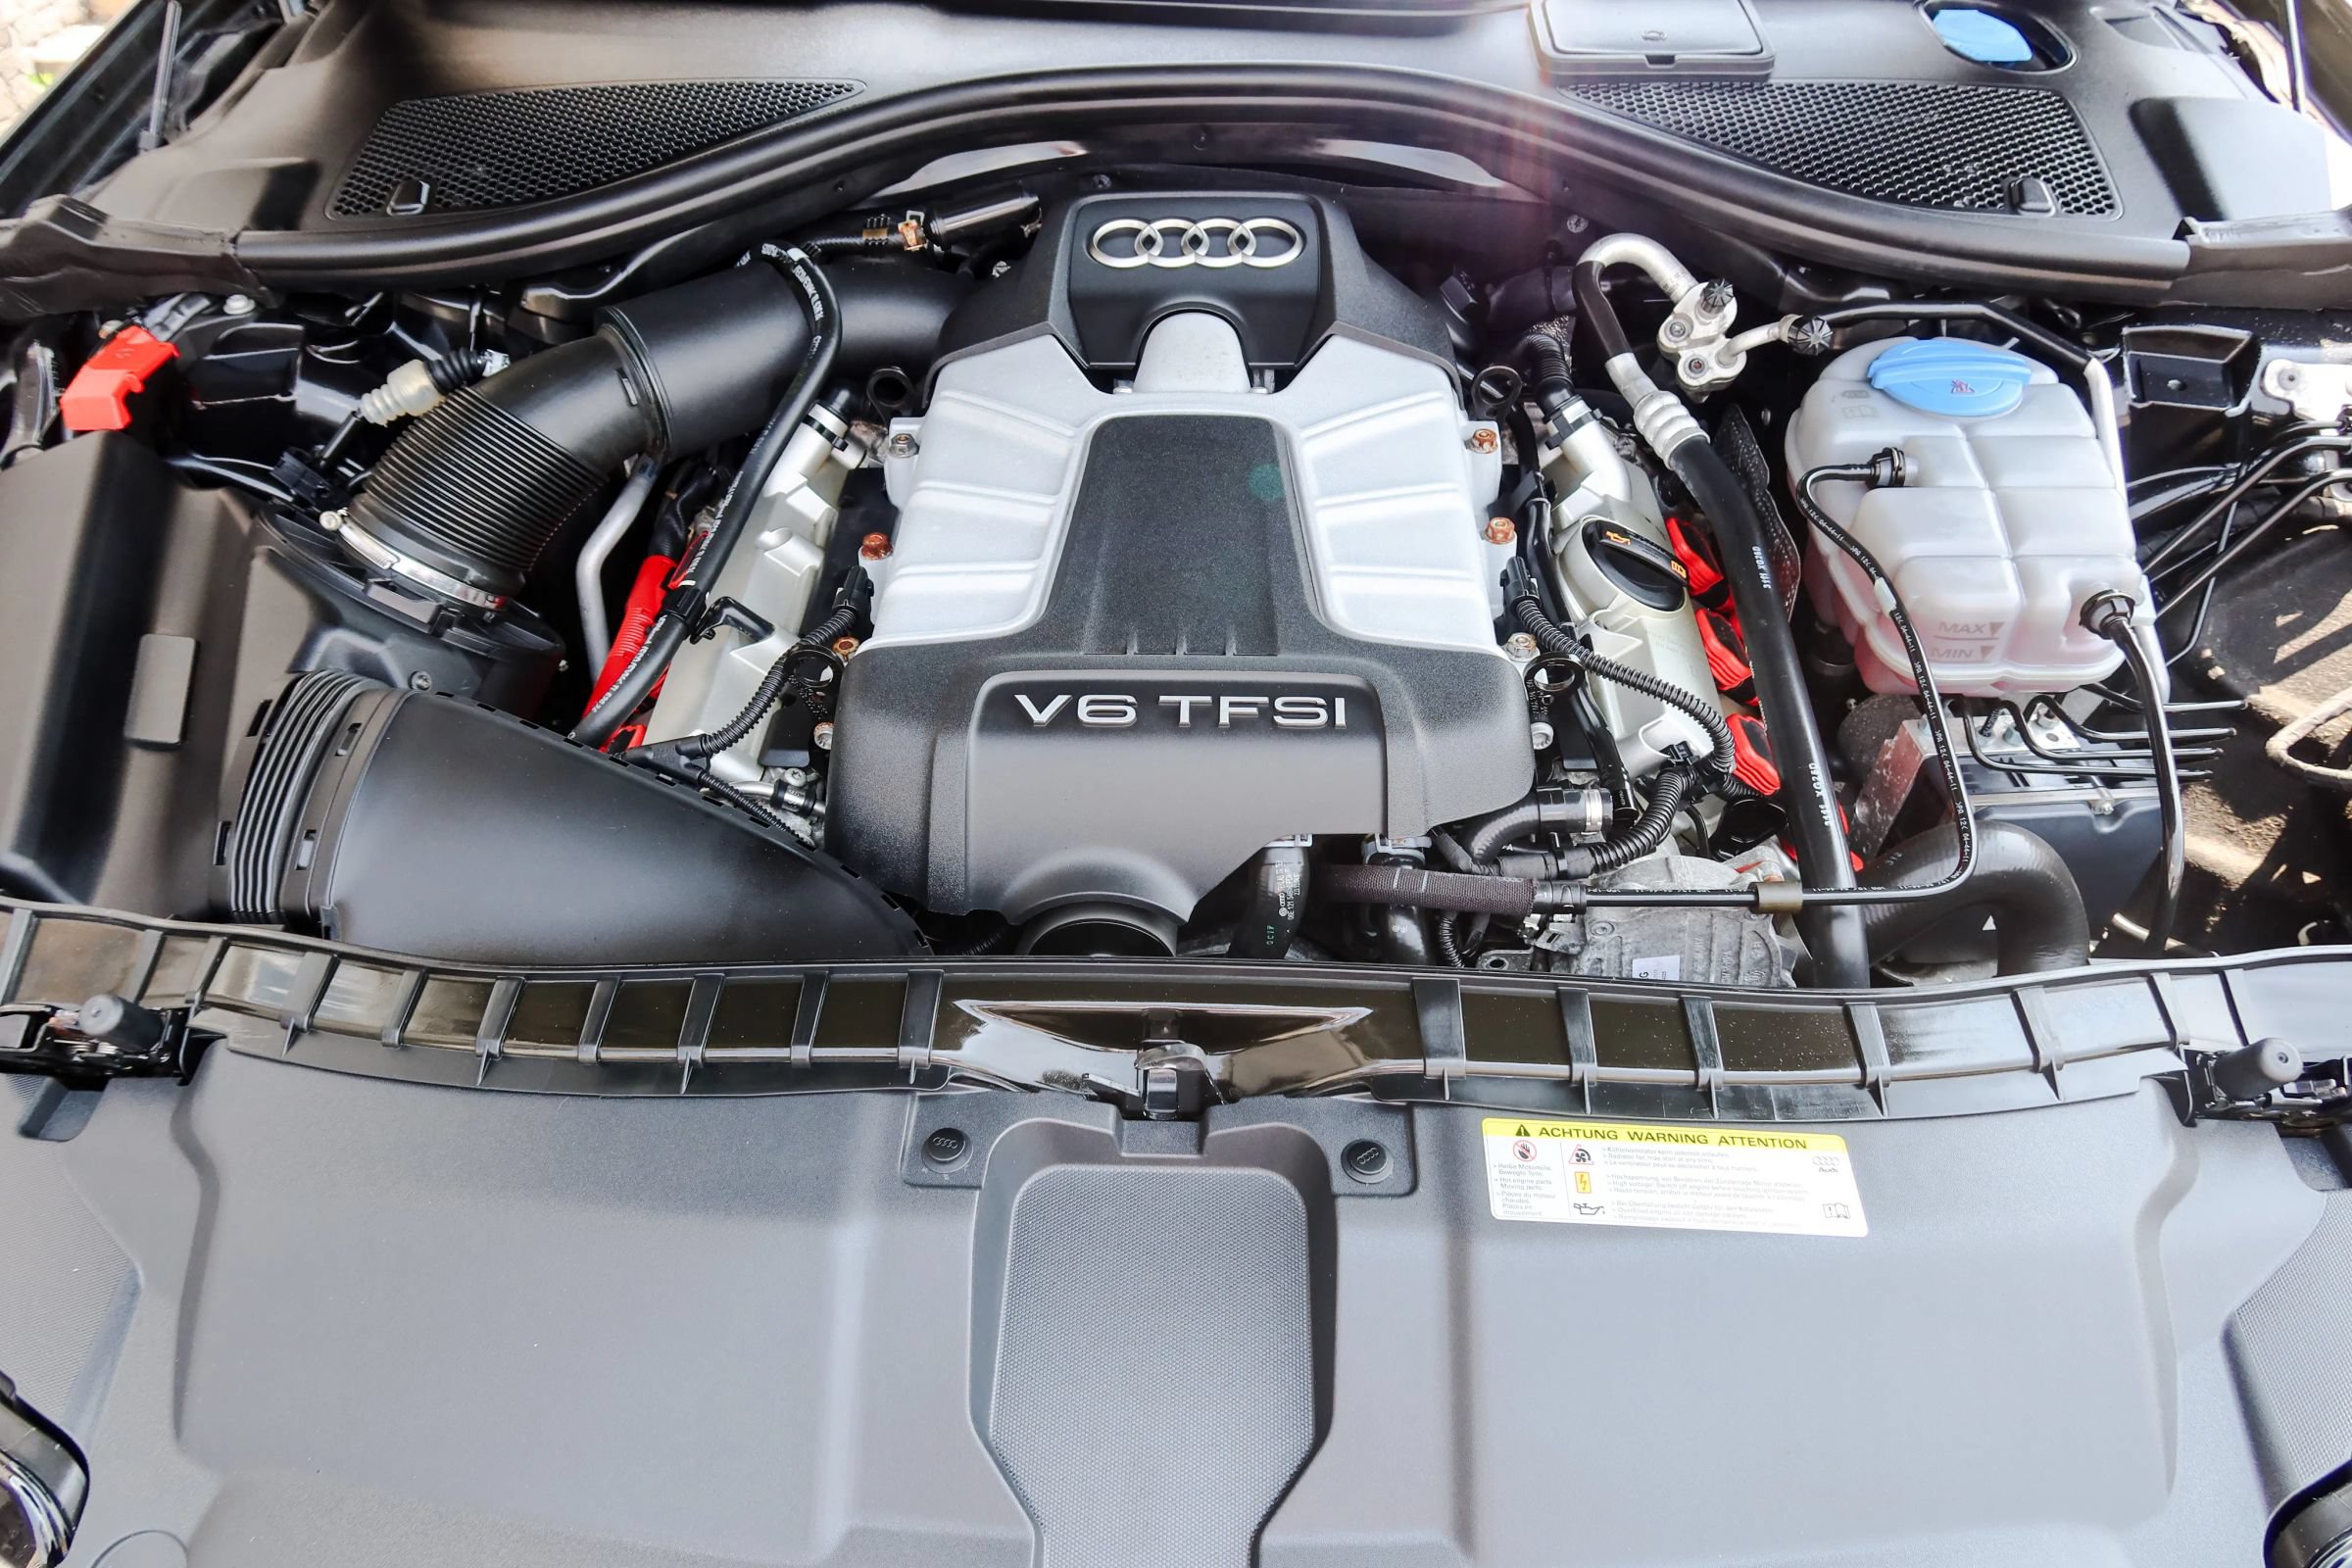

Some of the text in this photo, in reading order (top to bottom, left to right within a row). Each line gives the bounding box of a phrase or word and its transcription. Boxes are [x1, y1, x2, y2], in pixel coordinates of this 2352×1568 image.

[1938, 621, 1987, 634] MAX
[1931, 647, 1975, 659] MIN
[1014, 694, 1348, 730] V6 TFSI
[1539, 1127, 1807, 1149] ACHTUNG WARNING ATTENTION
